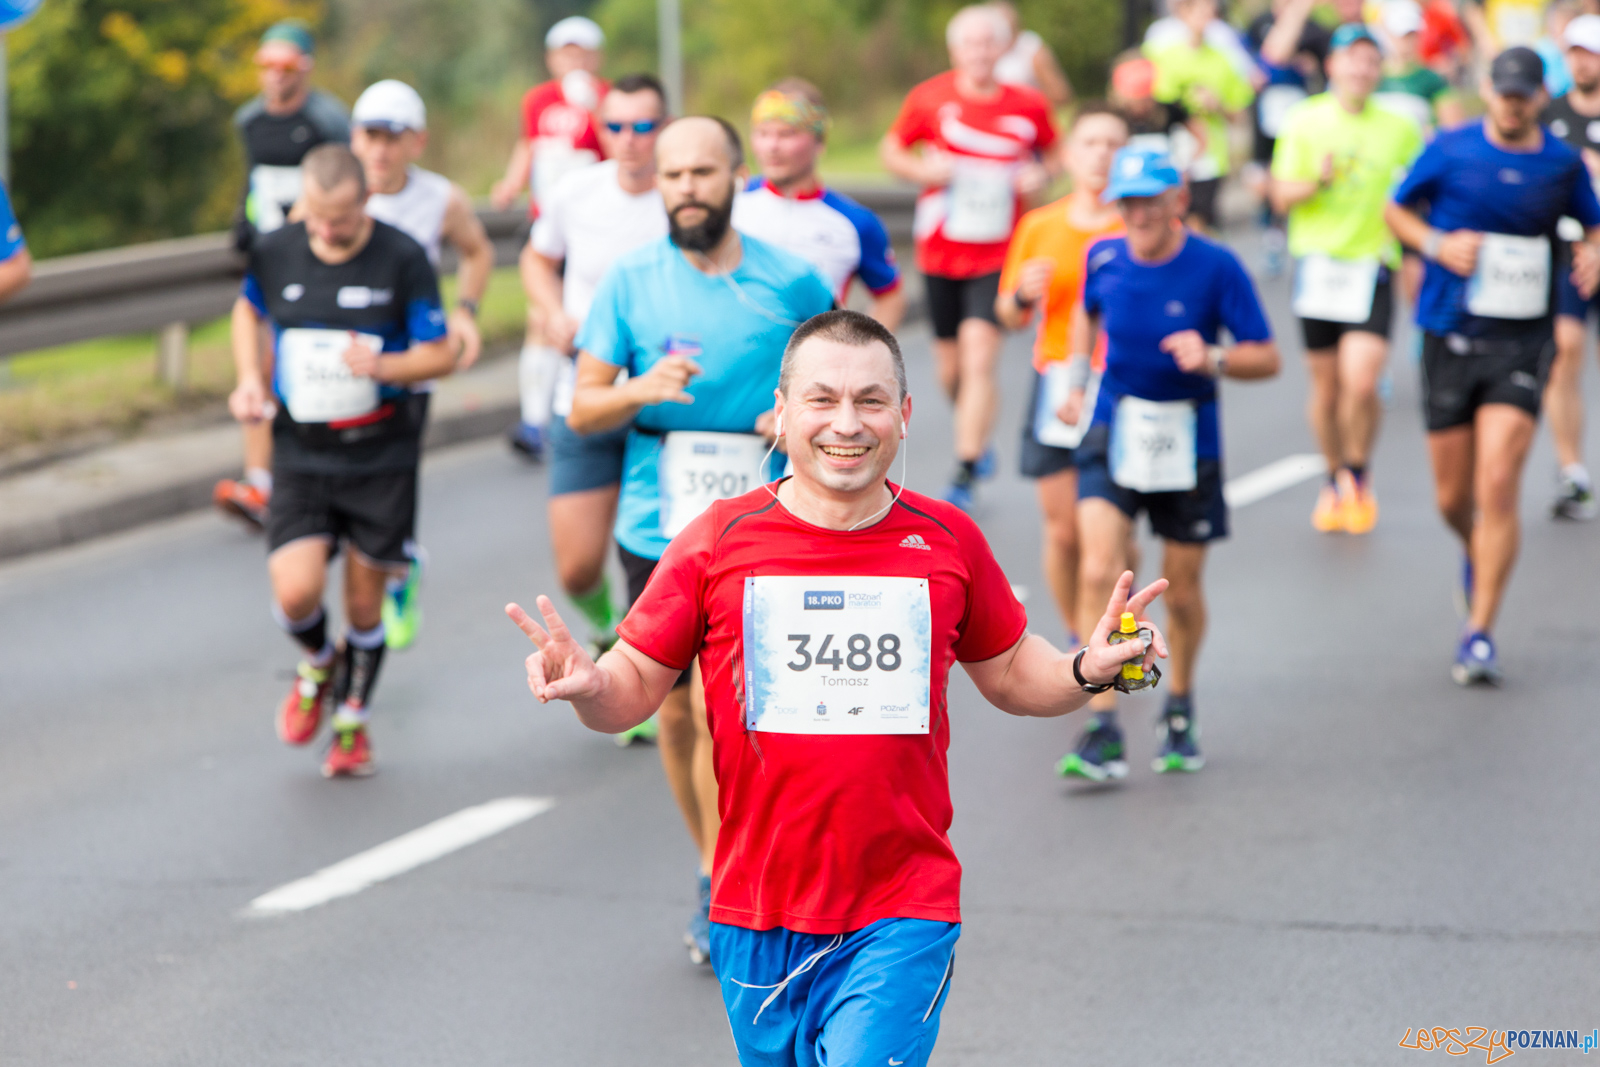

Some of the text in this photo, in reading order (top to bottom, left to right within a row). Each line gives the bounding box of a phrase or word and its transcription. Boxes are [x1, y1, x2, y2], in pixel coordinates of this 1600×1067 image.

[685, 470, 747, 496] 3901
[821, 596, 842, 605] PKO
[787, 633, 902, 672] 3488
[820, 675, 870, 687] Tomasz
[847, 706, 865, 716] 4F
